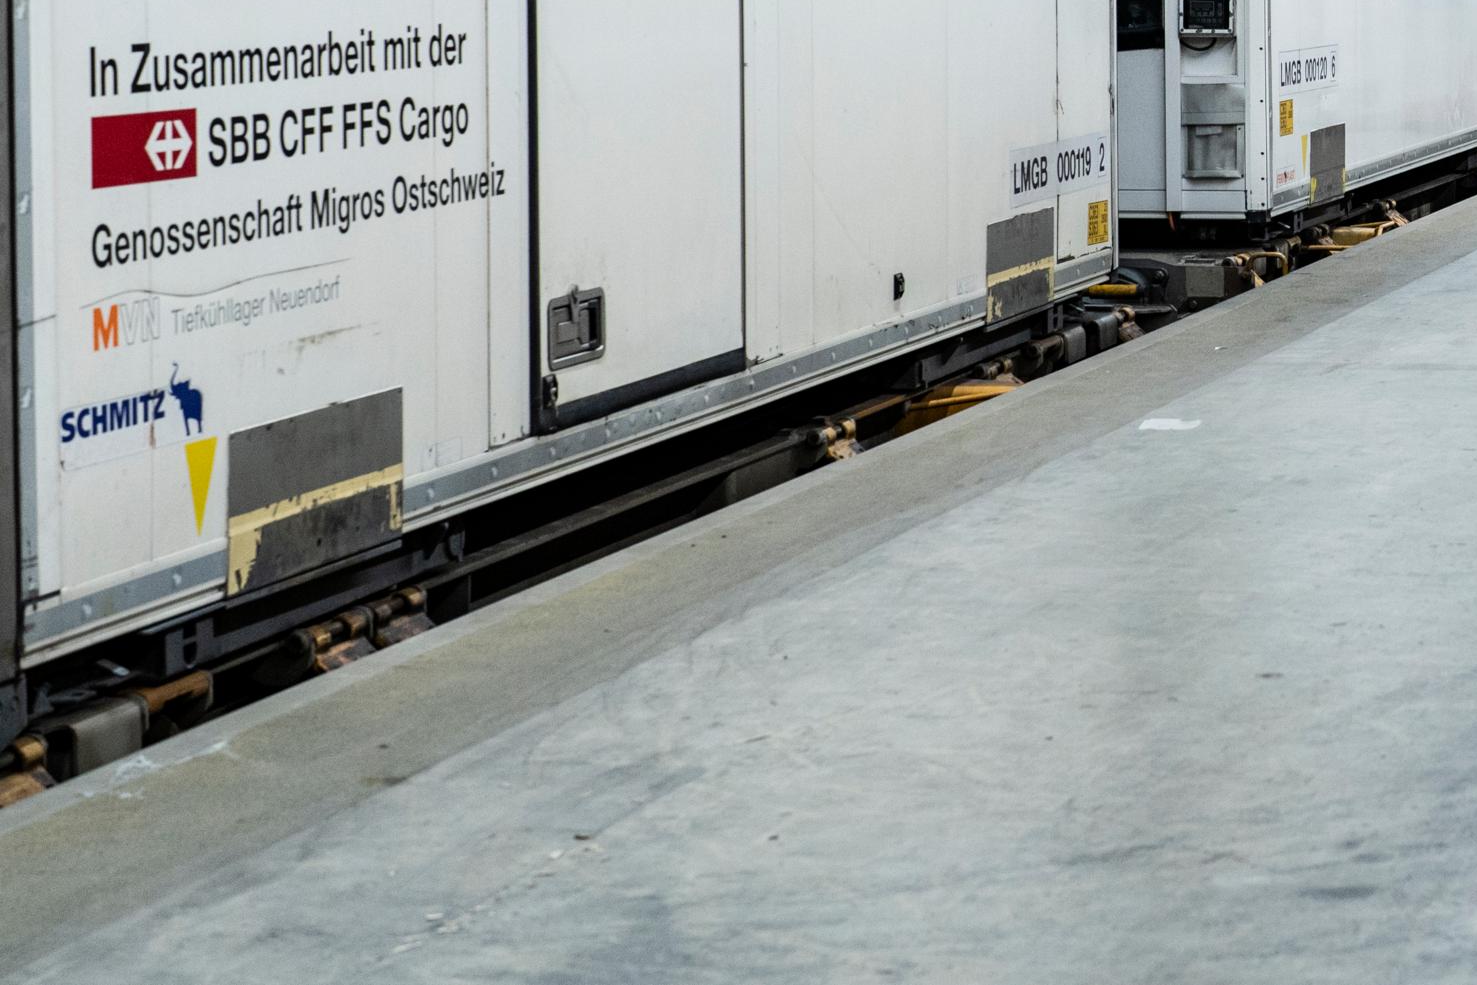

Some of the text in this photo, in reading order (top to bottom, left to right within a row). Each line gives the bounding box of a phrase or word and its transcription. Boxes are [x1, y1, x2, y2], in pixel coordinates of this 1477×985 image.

[90, 23, 467, 97] In Zusammenarbeit mit der
[1281, 55, 1336, 87] LMGB 000120 6
[208, 96, 469, 167] SBB CFF FFS Cargo
[1013, 142, 1105, 195] LMGB 000119 2
[92, 161, 506, 268] Genossenschaft Migros Ostschweiz
[170, 296, 266, 335] Tiefkühllager
[268, 275, 341, 314] Neuendorf
[61, 389, 166, 443] SCHMITZ
